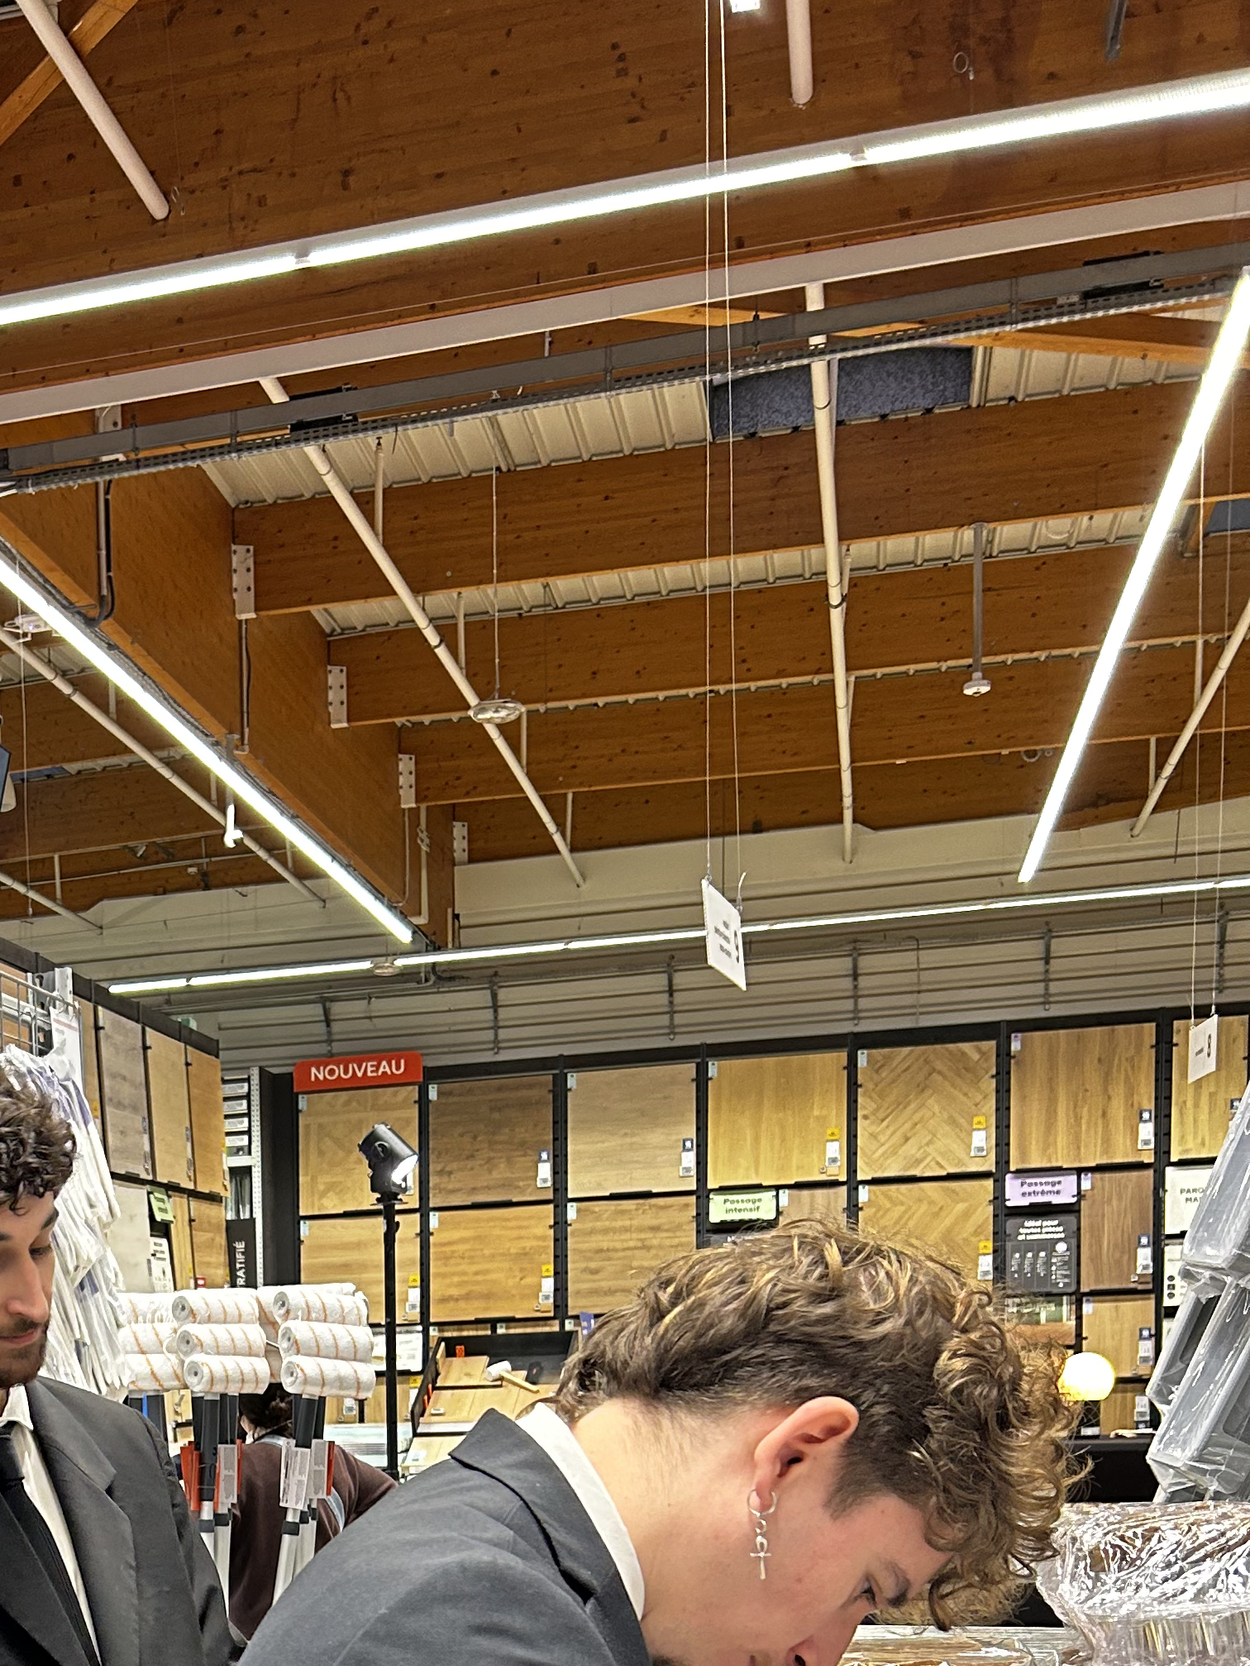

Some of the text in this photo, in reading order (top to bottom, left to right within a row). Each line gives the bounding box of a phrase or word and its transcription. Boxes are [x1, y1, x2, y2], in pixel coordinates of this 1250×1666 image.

[311, 1059, 405, 1082] NOUVEAU
[724, 1197, 762, 1205] Passage
[725, 1206, 760, 1214] intensif
